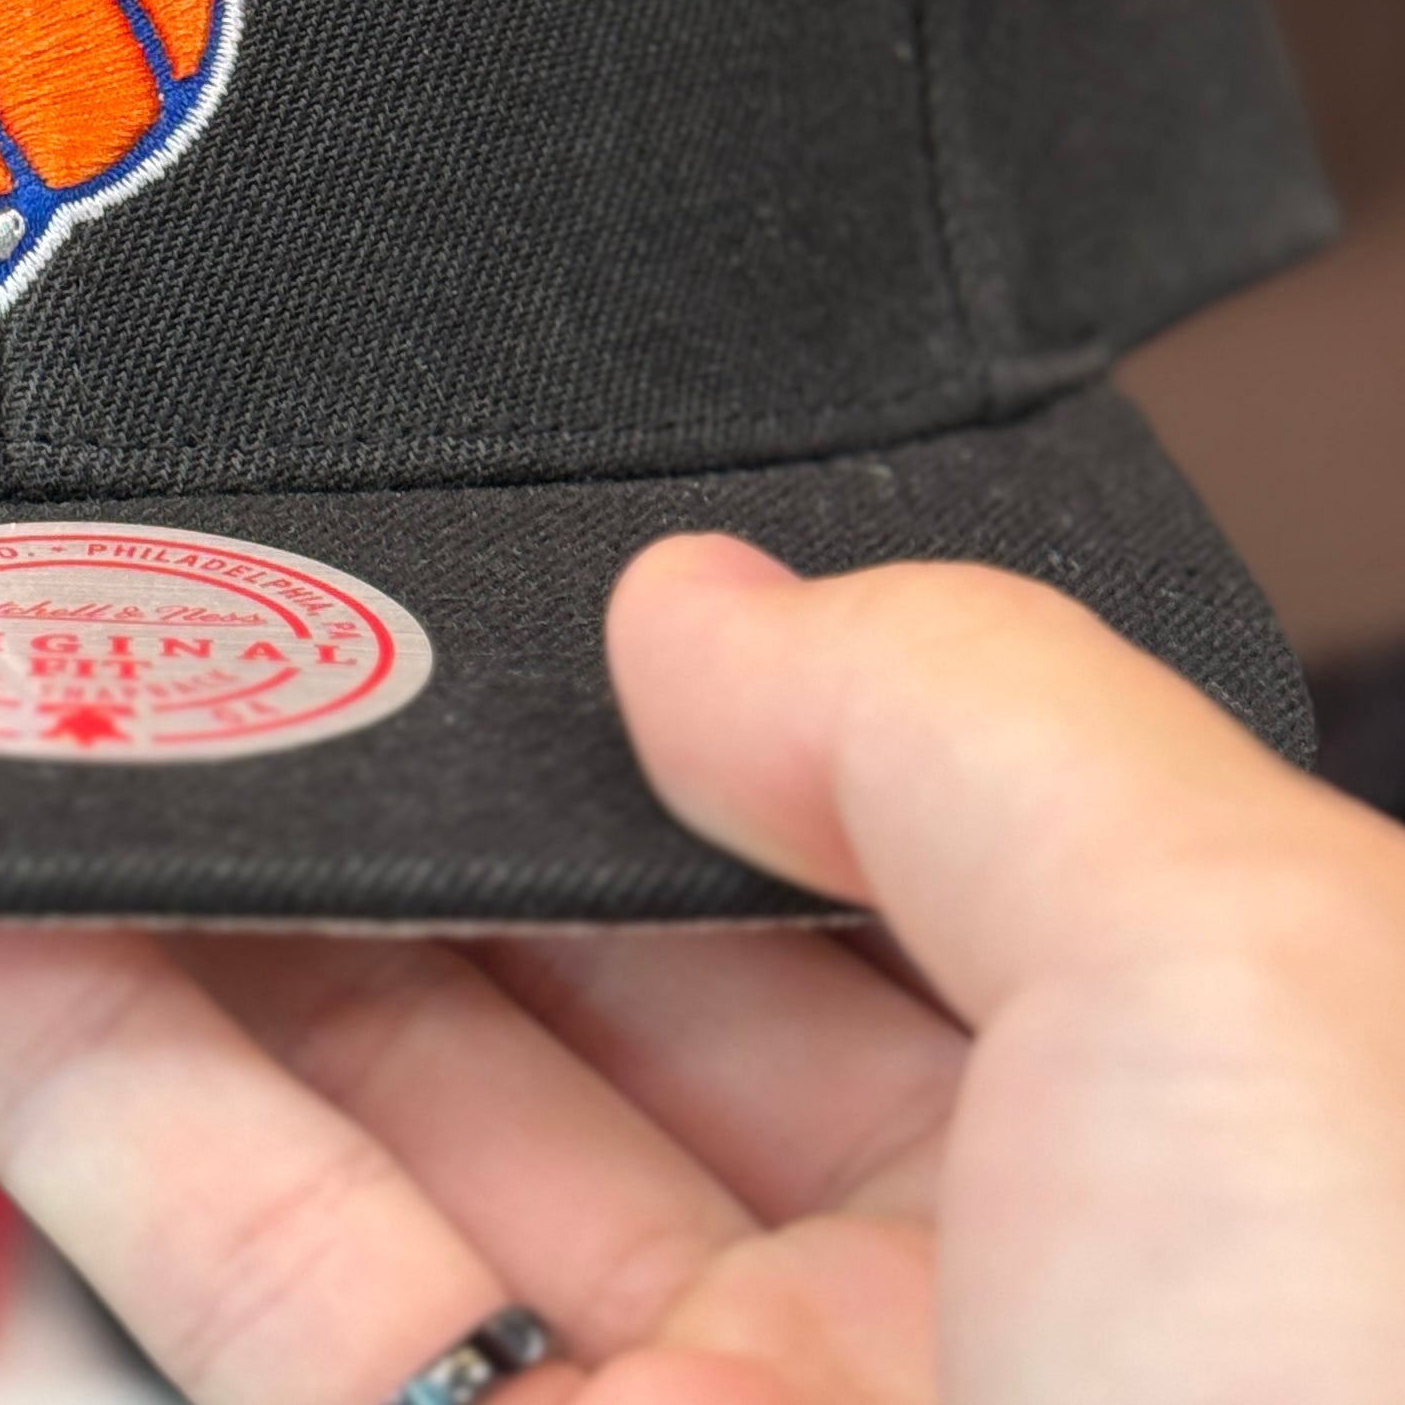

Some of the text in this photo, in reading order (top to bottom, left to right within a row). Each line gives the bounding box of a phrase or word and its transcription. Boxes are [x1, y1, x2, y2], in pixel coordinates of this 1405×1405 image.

[114, 605, 145, 619] &
[154, 605, 269, 624] Ness
[27, 657, 154, 682] FIT
